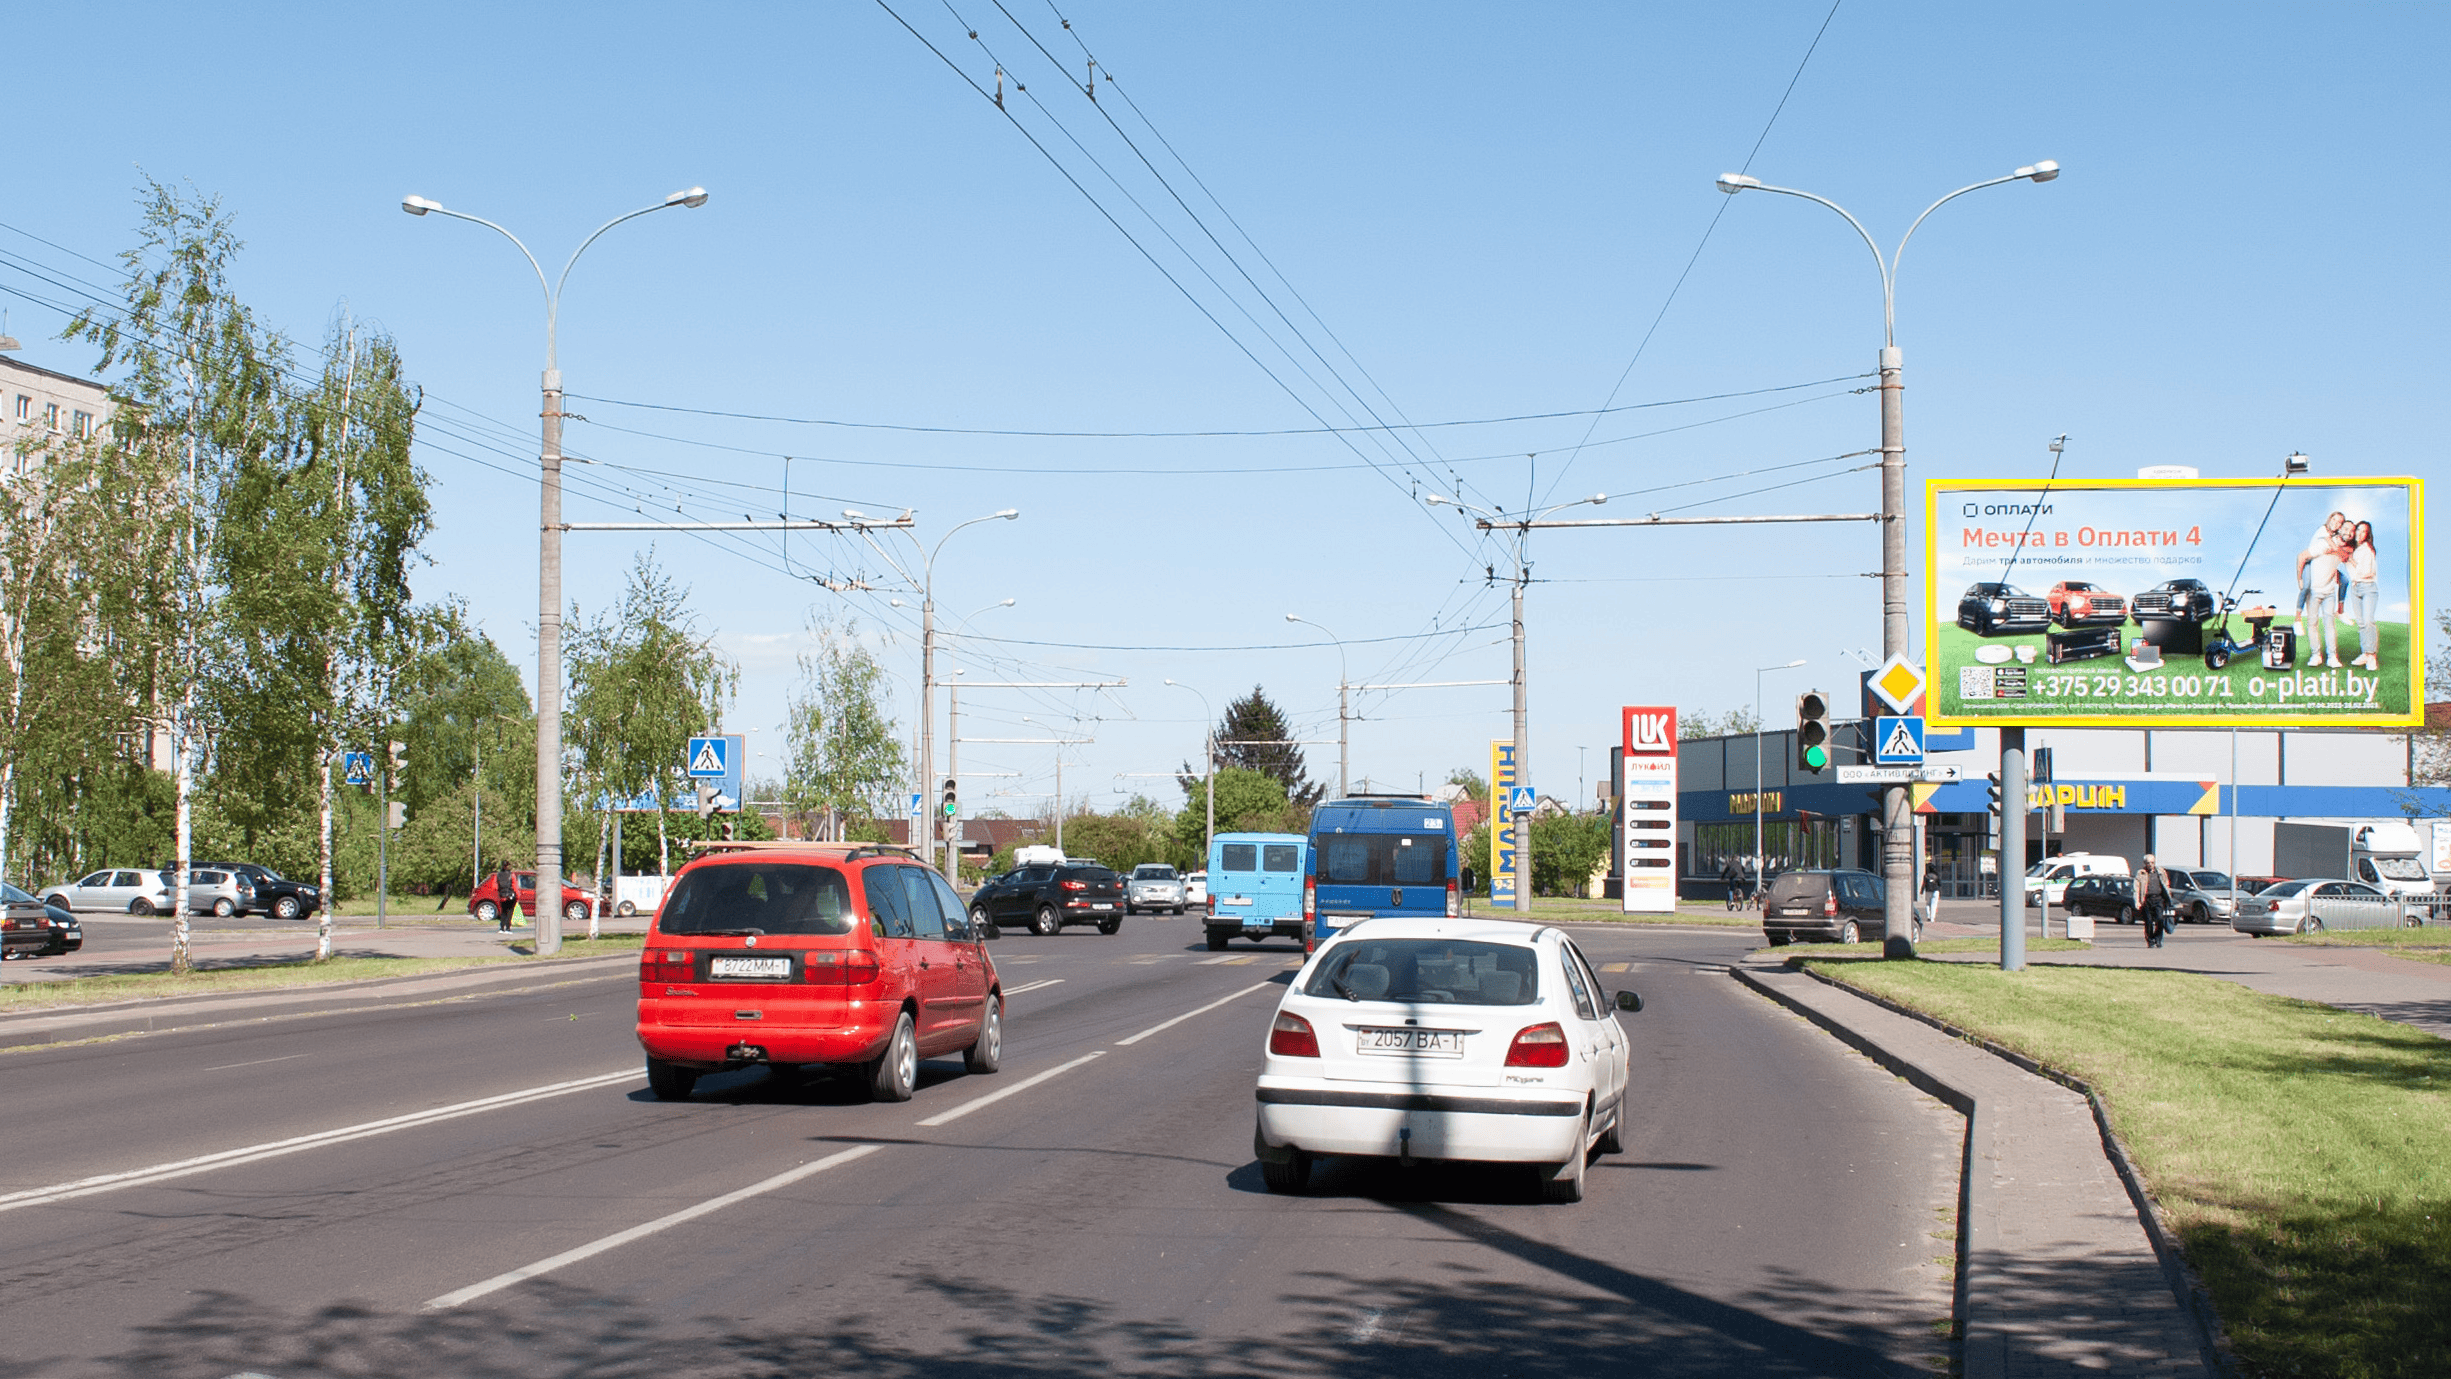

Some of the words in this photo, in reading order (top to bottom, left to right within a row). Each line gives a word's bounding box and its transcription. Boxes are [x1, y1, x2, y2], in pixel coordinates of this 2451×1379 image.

[1984, 504, 2053, 516] ОПЛАТИ
[1963, 527, 2046, 548] Мечта
[2055, 531, 2069, 547] в
[2078, 526, 2177, 547] Оплати
[2186, 525, 2202, 547] 4
[1963, 556, 1996, 566] Дарим
[1999, 557, 2017, 567] три
[2020, 554, 2083, 565] автомобиля
[2094, 556, 2151, 565] множество
[2154, 556, 2203, 566] подарков
[2032, 675, 2089, 697] +375
[2093, 675, 2121, 697] 29
[2125, 675, 2167, 697] 343
[2172, 675, 2201, 697] 00
[2204, 675, 2234, 697] 71
[2249, 669, 2379, 703] o-plati.by
[1843, 770, 1863, 779] ООО
[2028, 784, 2126, 808] АРЦІН
[1374, 1029, 1414, 1049] 2057
[1416, 1032, 1459, 1051] BA-1
